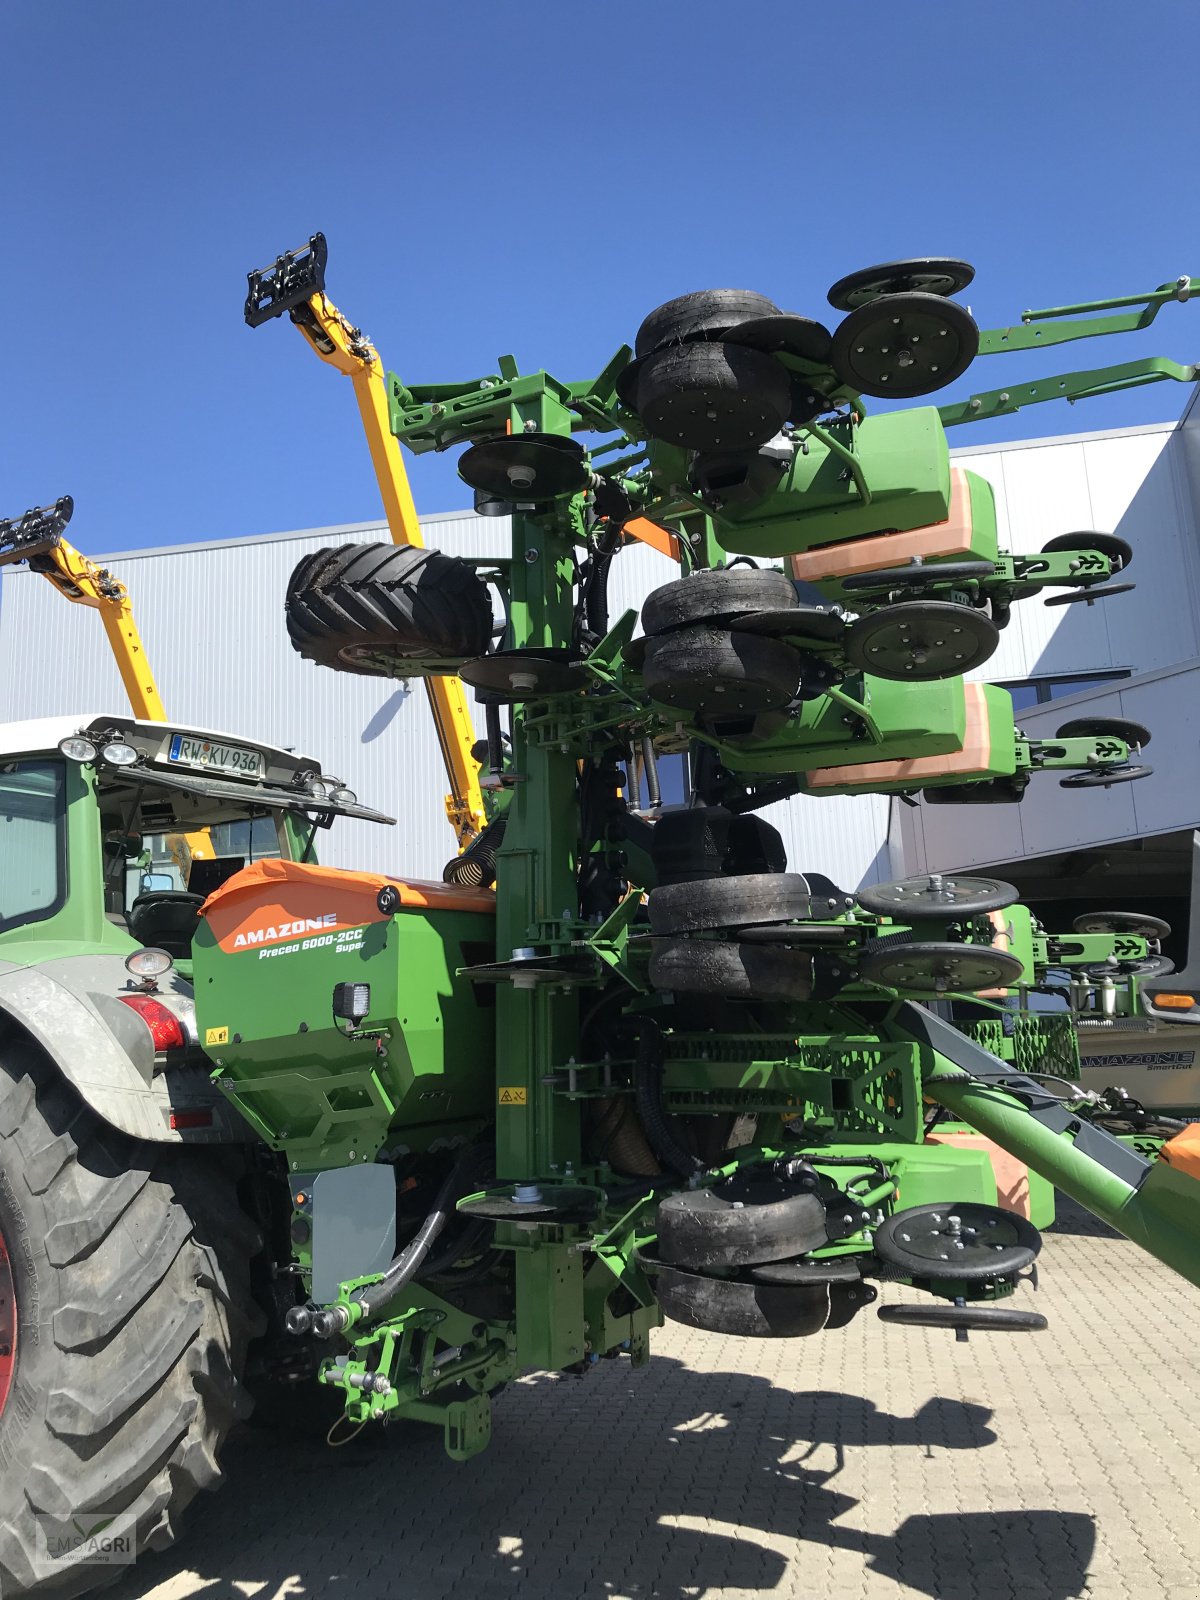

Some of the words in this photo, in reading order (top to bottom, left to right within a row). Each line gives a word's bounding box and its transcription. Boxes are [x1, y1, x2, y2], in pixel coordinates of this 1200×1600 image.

[180, 740, 202, 760] RW
[208, 746, 230, 765] KV
[232, 751, 256, 771] 936
[233, 913, 337, 948] AMAZONE
[259, 943, 300, 959] Precea
[301, 929, 363, 950] 6000-2CC
[335, 941, 366, 953] Super
[1146, 1063, 1193, 1071] SmartCut
